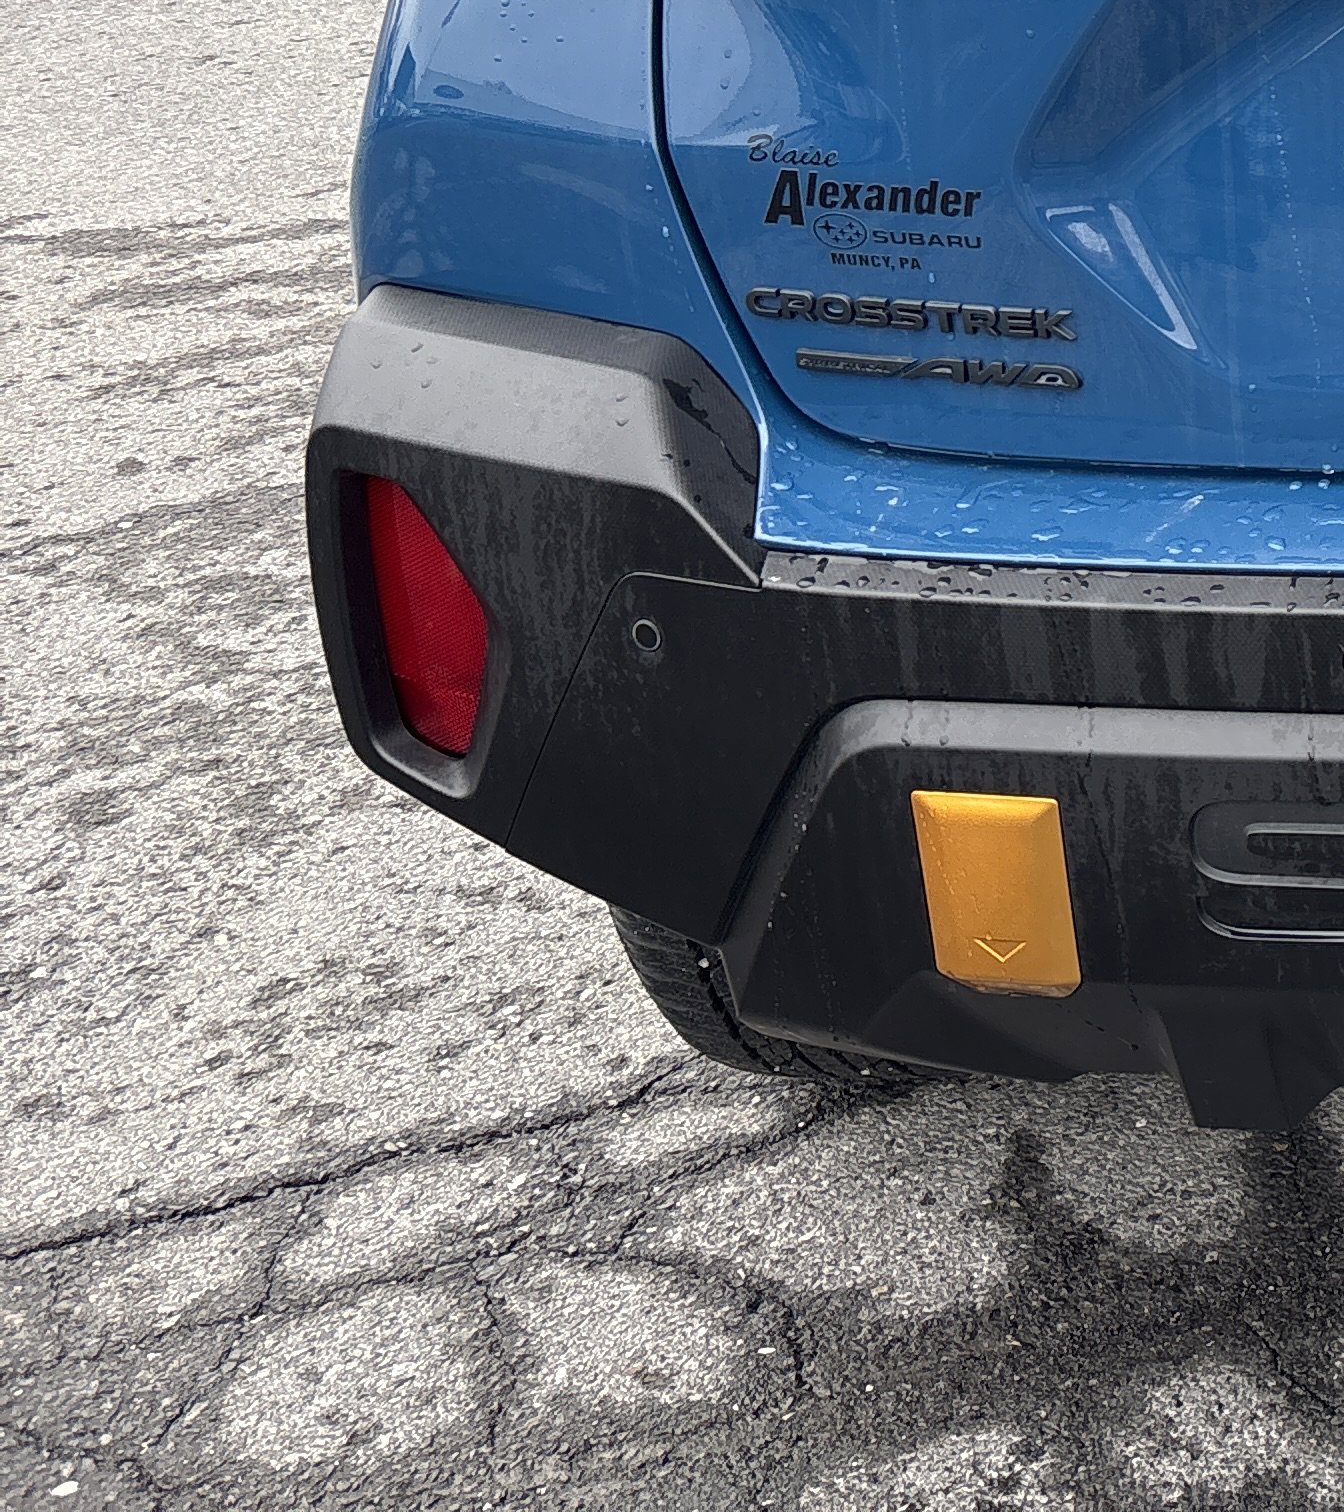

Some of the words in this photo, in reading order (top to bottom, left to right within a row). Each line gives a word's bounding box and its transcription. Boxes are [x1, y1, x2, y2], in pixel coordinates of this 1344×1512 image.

[746, 133, 840, 168] Blaise
[763, 168, 983, 228] Alexander
[871, 229, 982, 249] SUBARU
[831, 252, 896, 272] MUNCY,
[899, 255, 922, 271] PA
[745, 287, 1078, 342] CROSSTREK
[902, 356, 1084, 389] AWD
